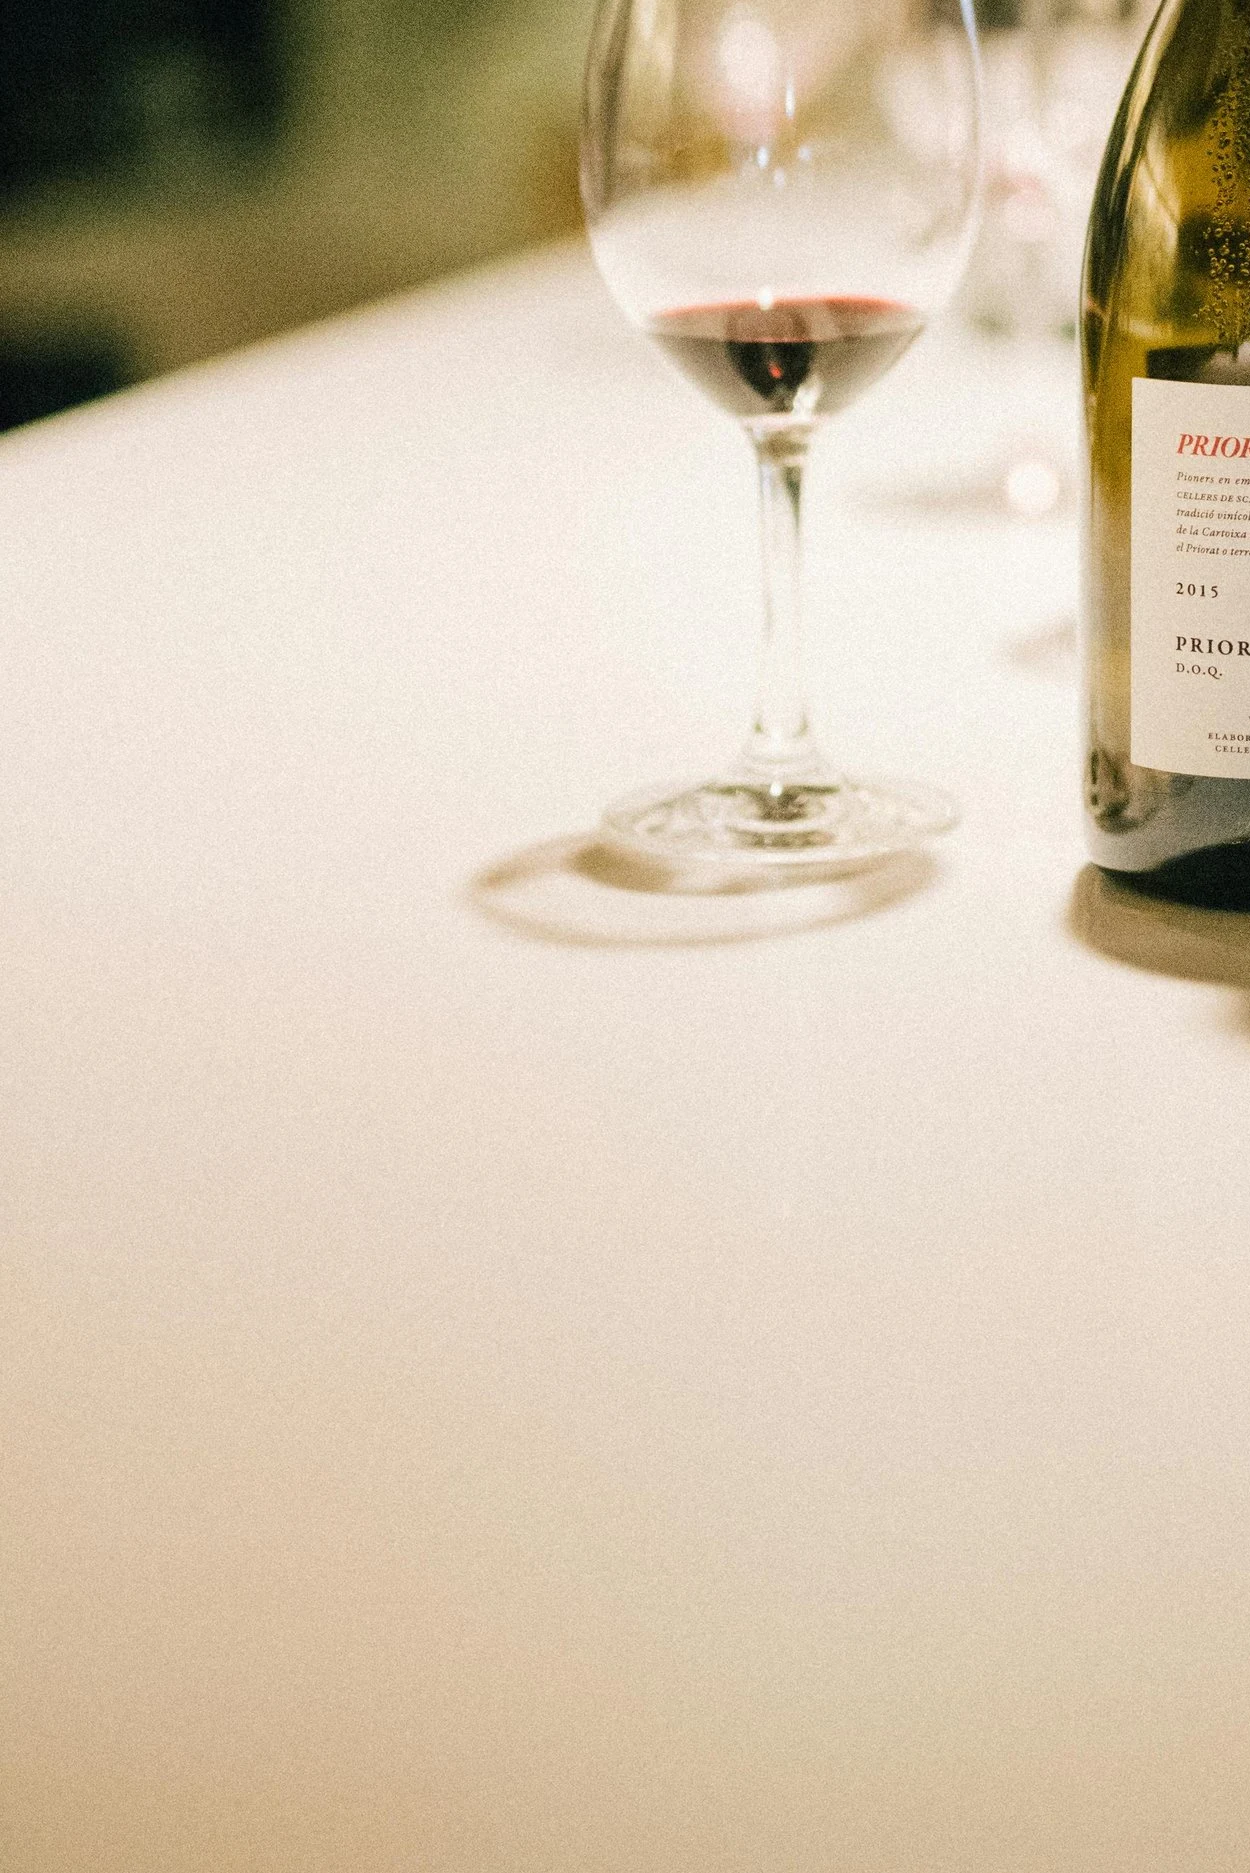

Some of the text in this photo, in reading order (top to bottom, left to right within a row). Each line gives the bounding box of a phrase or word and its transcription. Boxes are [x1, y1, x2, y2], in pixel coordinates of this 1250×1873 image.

[1177, 472, 1214, 483] Pioners
[1218, 474, 1231, 485] en
[1176, 491, 1218, 502] CELLERS
[1220, 494, 1234, 503] DE
[1176, 508, 1214, 519] tradició
[1176, 524, 1187, 535] de
[1189, 525, 1199, 536] la
[1202, 526, 1247, 539] Cartoixa
[1176, 542, 1184, 553] el
[1186, 543, 1220, 555] Priorat
[1222, 548, 1228, 556] o
[1175, 582, 1219, 598] 2015
[1175, 662, 1223, 680] D.O.Q.
